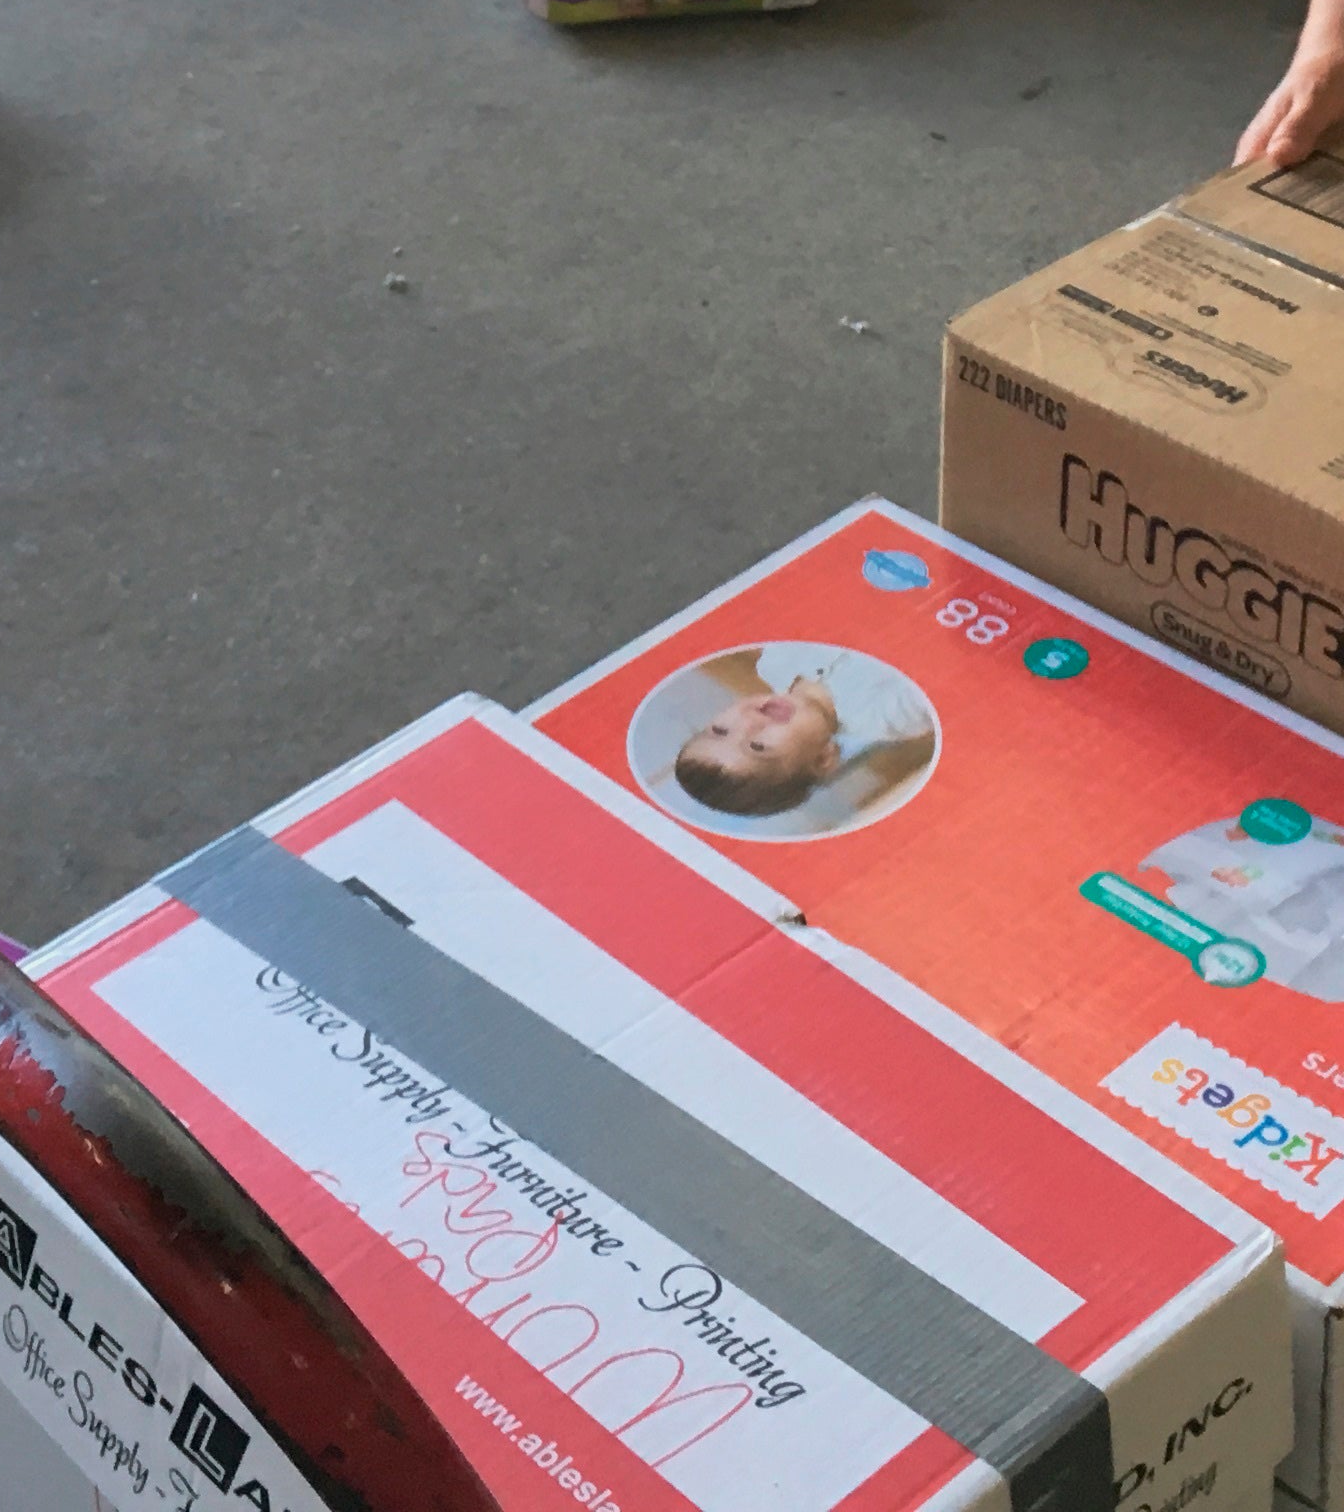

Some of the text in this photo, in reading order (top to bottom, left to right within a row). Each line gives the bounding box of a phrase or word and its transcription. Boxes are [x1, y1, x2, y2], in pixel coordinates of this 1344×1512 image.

[959, 356, 1068, 431] 222 DIAPERS
[936, 597, 1010, 646] 88
[1160, 610, 1278, 691] Snug & Dry
[331, 1026, 449, 1123] Supply
[443, 1113, 624, 1258] Furniture
[637, 1262, 807, 1409] Printing
[3, 1303, 66, 1400] Office
[67, 1369, 150, 1494] Supply
[1162, 1376, 1254, 1466] INC.
